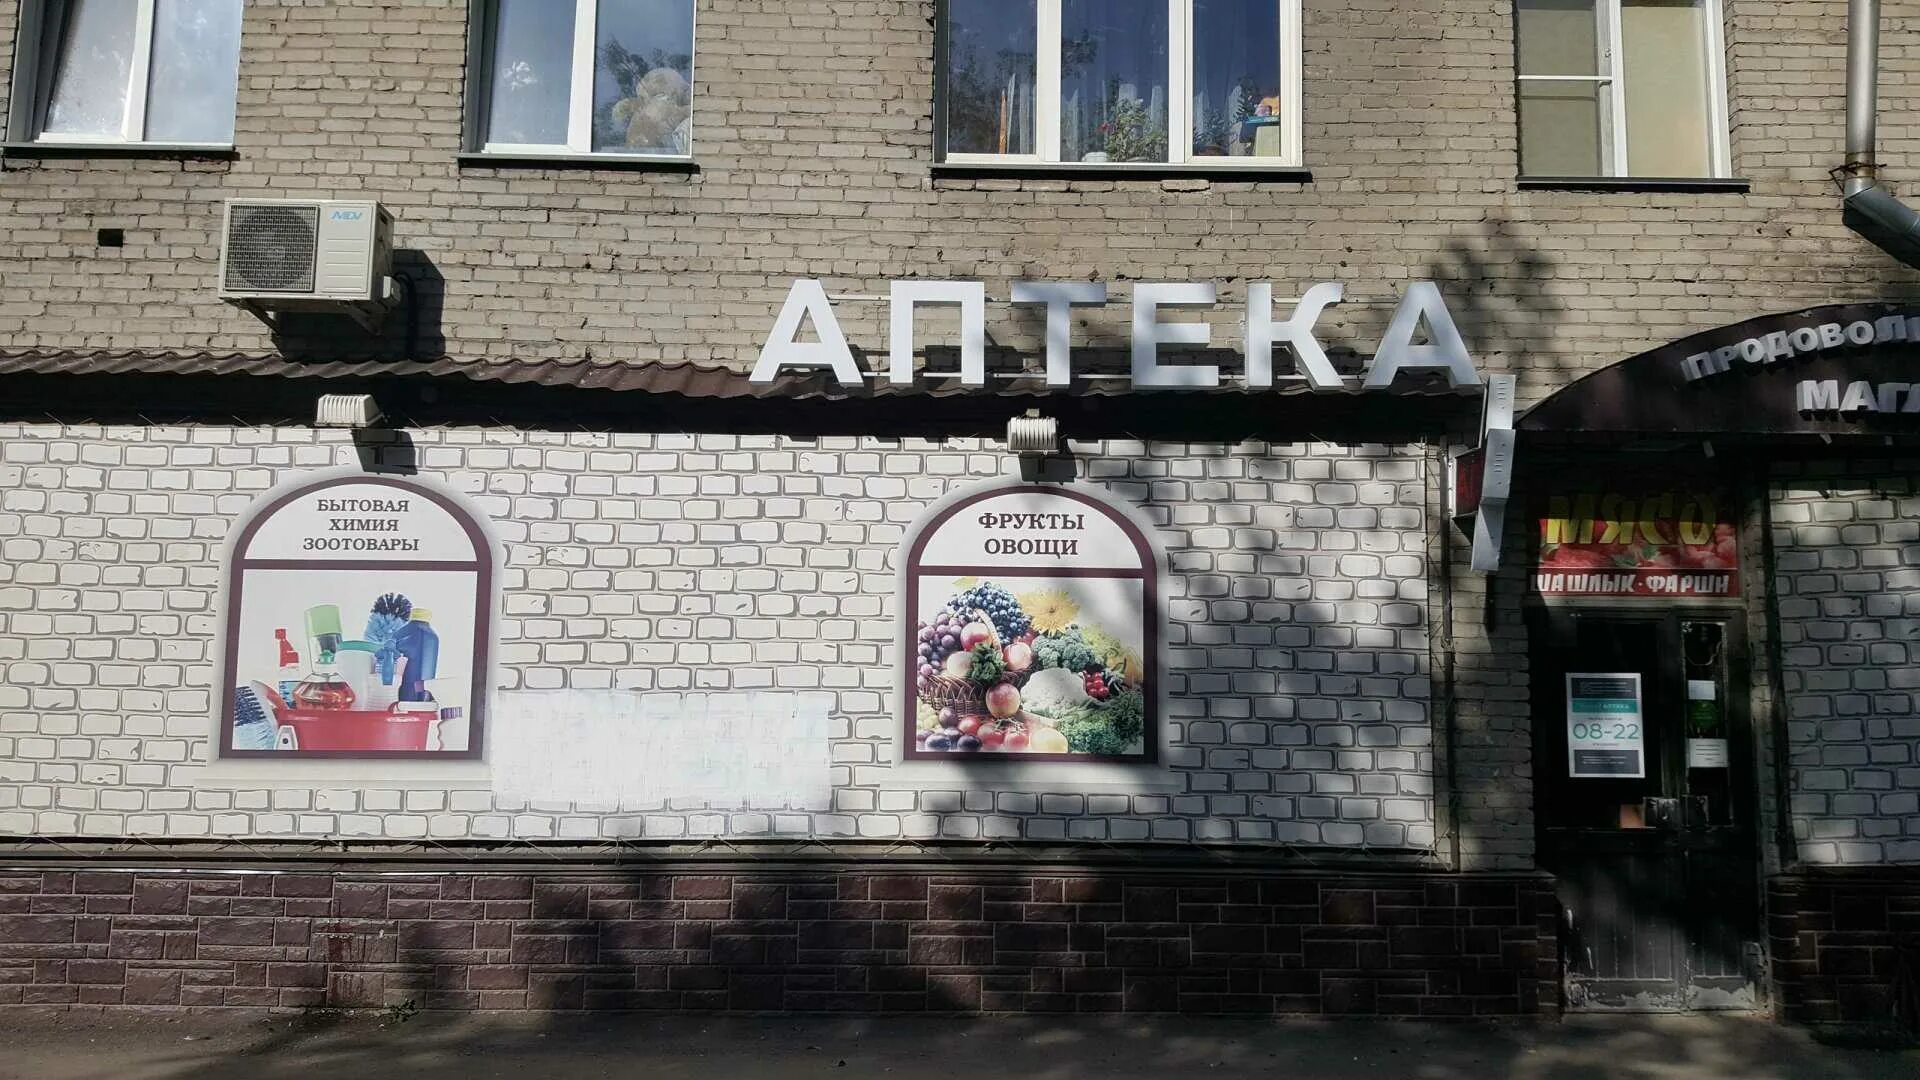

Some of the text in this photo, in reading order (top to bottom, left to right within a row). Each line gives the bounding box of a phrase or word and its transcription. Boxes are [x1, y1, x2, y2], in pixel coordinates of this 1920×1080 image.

[749, 279, 1482, 390] АПТЕКА
[317, 499, 409, 513] БЫТОВАЯ
[328, 518, 400, 532] ХИМИЯ
[978, 512, 1085, 530] ФРУКТЫ
[1546, 491, 1716, 545] МЯСО
[303, 537, 419, 551] ЗООТОВАРЫ
[984, 539, 1079, 560] ОВОЩИ
[1645, 573, 1729, 593] ФАРШИ
[1573, 723, 1640, 739] 08-22
